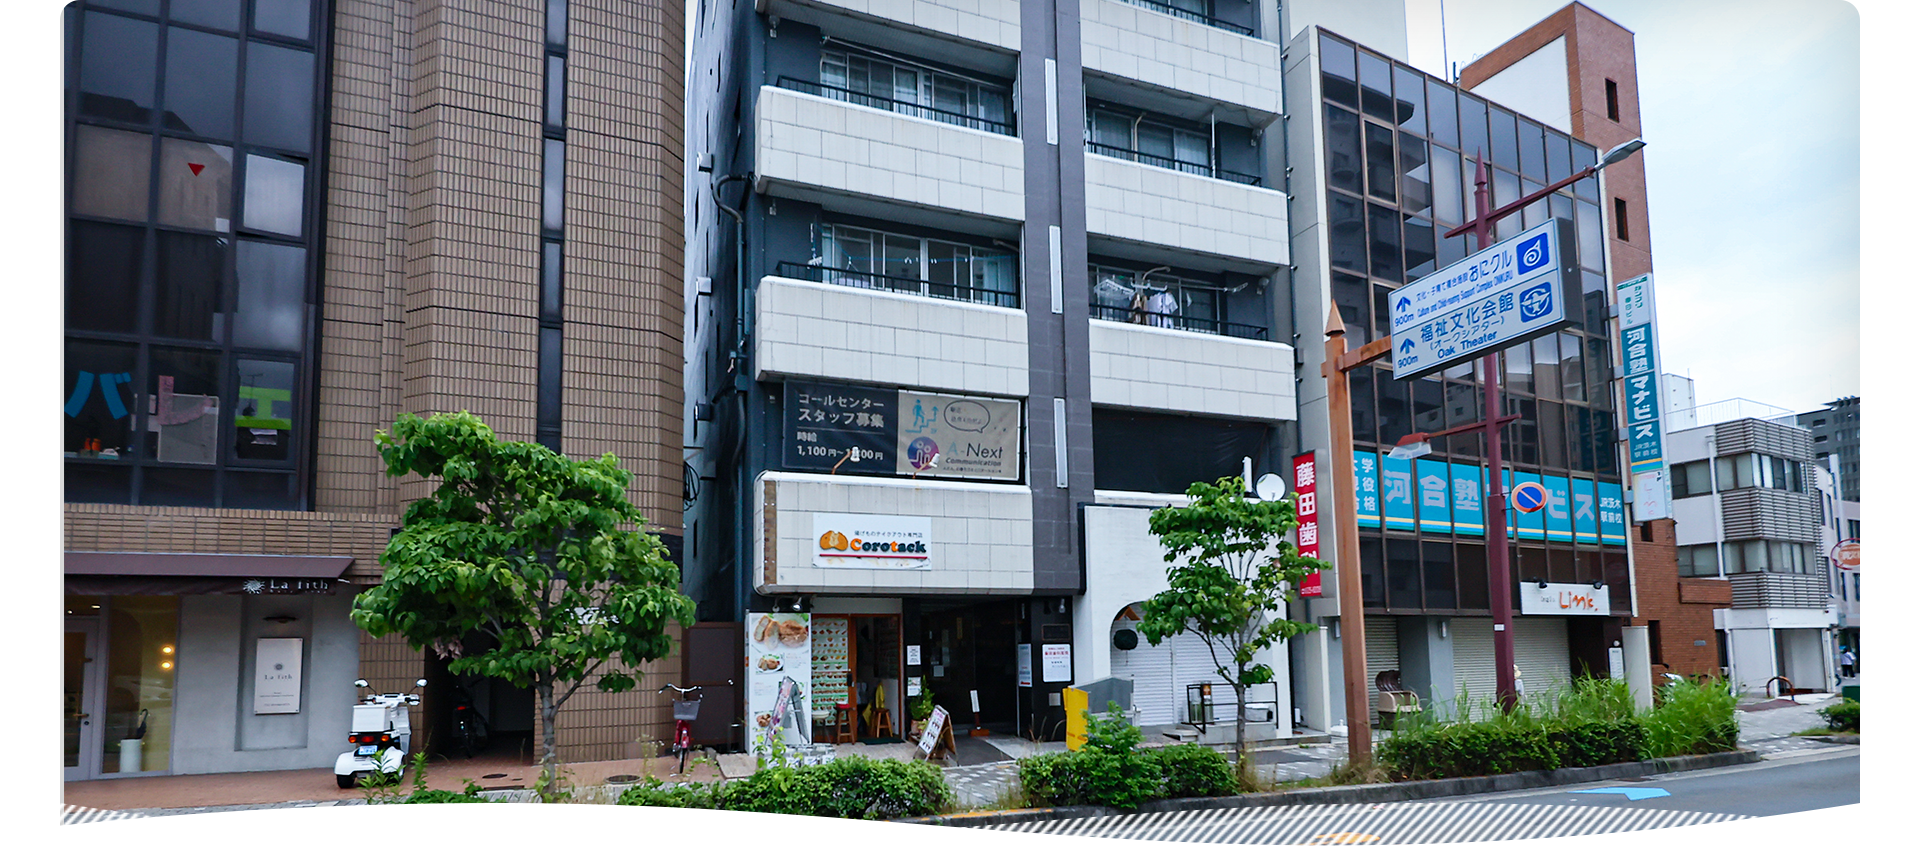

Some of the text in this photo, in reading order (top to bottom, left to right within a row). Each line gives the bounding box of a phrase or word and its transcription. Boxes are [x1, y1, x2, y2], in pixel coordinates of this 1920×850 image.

[1468, 250, 1513, 283] おにクル
[1394, 312, 1414, 327] 900m
[1420, 292, 1514, 343] 福祉文化会館
[1437, 330, 1497, 359] Oak Theater
[1397, 354, 1418, 369] 900m
[1626, 327, 1654, 440] 河合塾マナビス
[799, 393, 884, 409] コールセンター
[798, 408, 884, 428] スタッフ募集
[796, 431, 817, 442] 時給
[946, 441, 1003, 459] A-Next
[945, 457, 1002, 467] Communication
[1384, 469, 1595, 521] 河合塾ビス
[850, 538, 927, 553] Corotack
